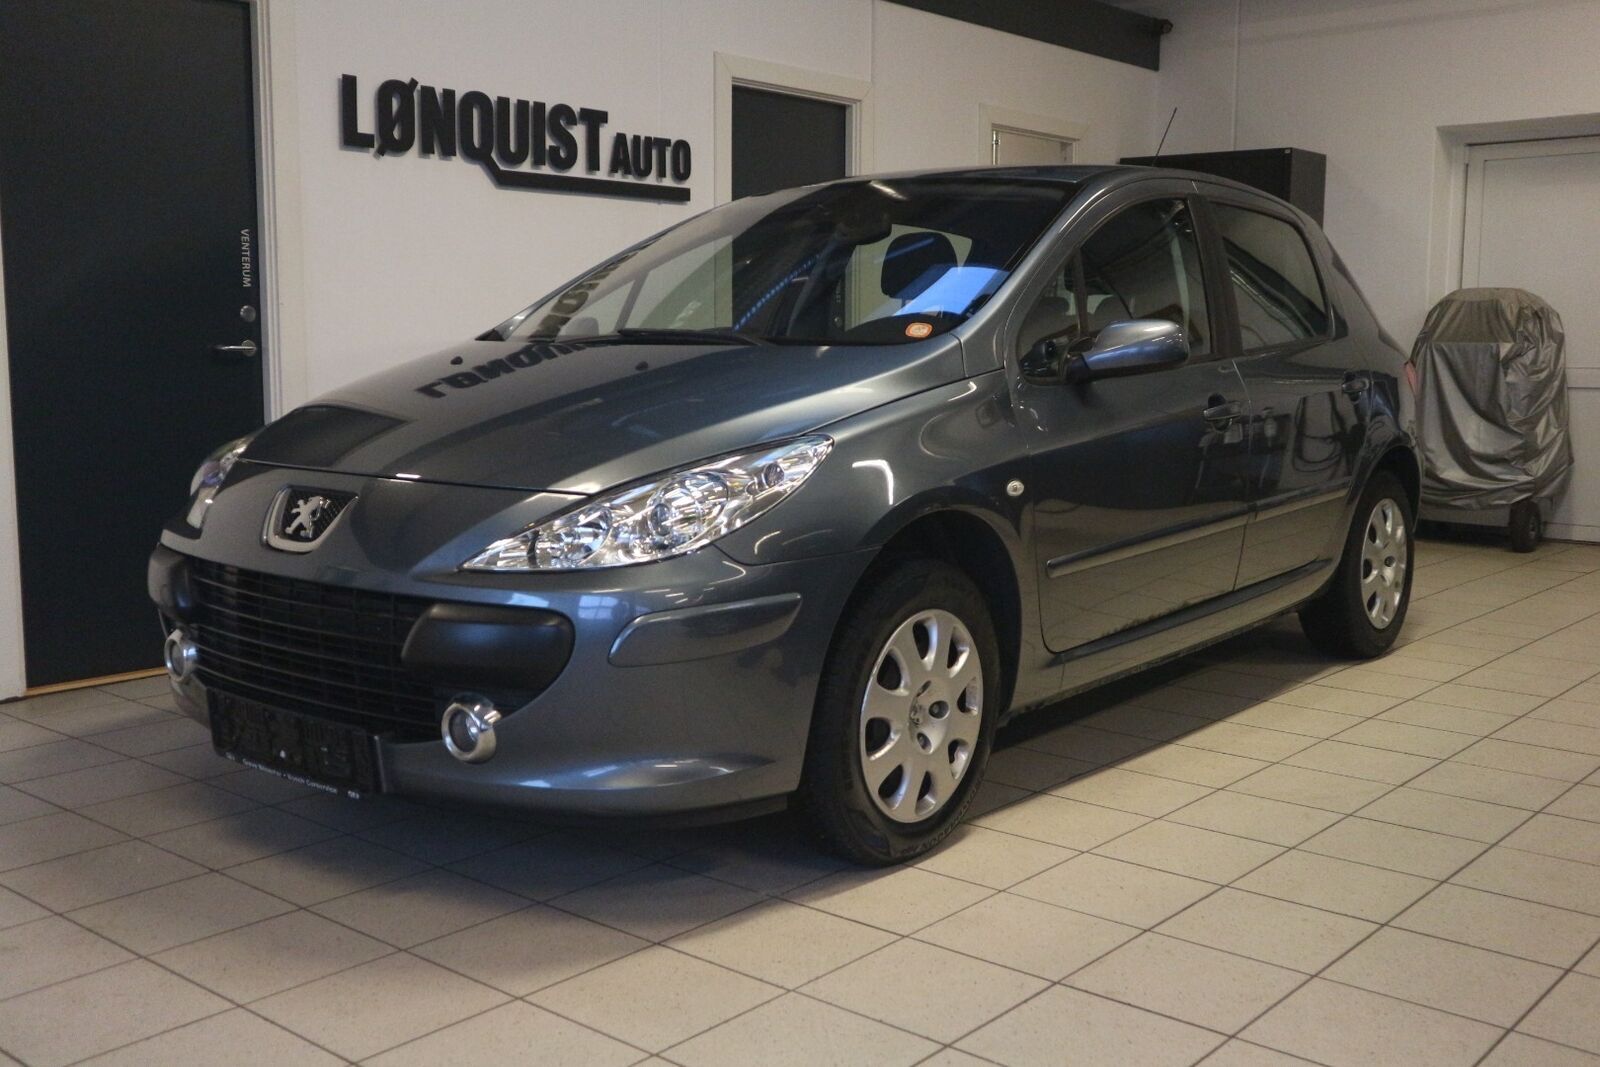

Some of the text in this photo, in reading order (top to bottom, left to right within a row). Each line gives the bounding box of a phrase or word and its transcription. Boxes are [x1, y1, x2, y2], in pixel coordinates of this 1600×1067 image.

[341, 73, 692, 181] LØNQUIST AUTO
[240, 228, 252, 288] VENTERUM
